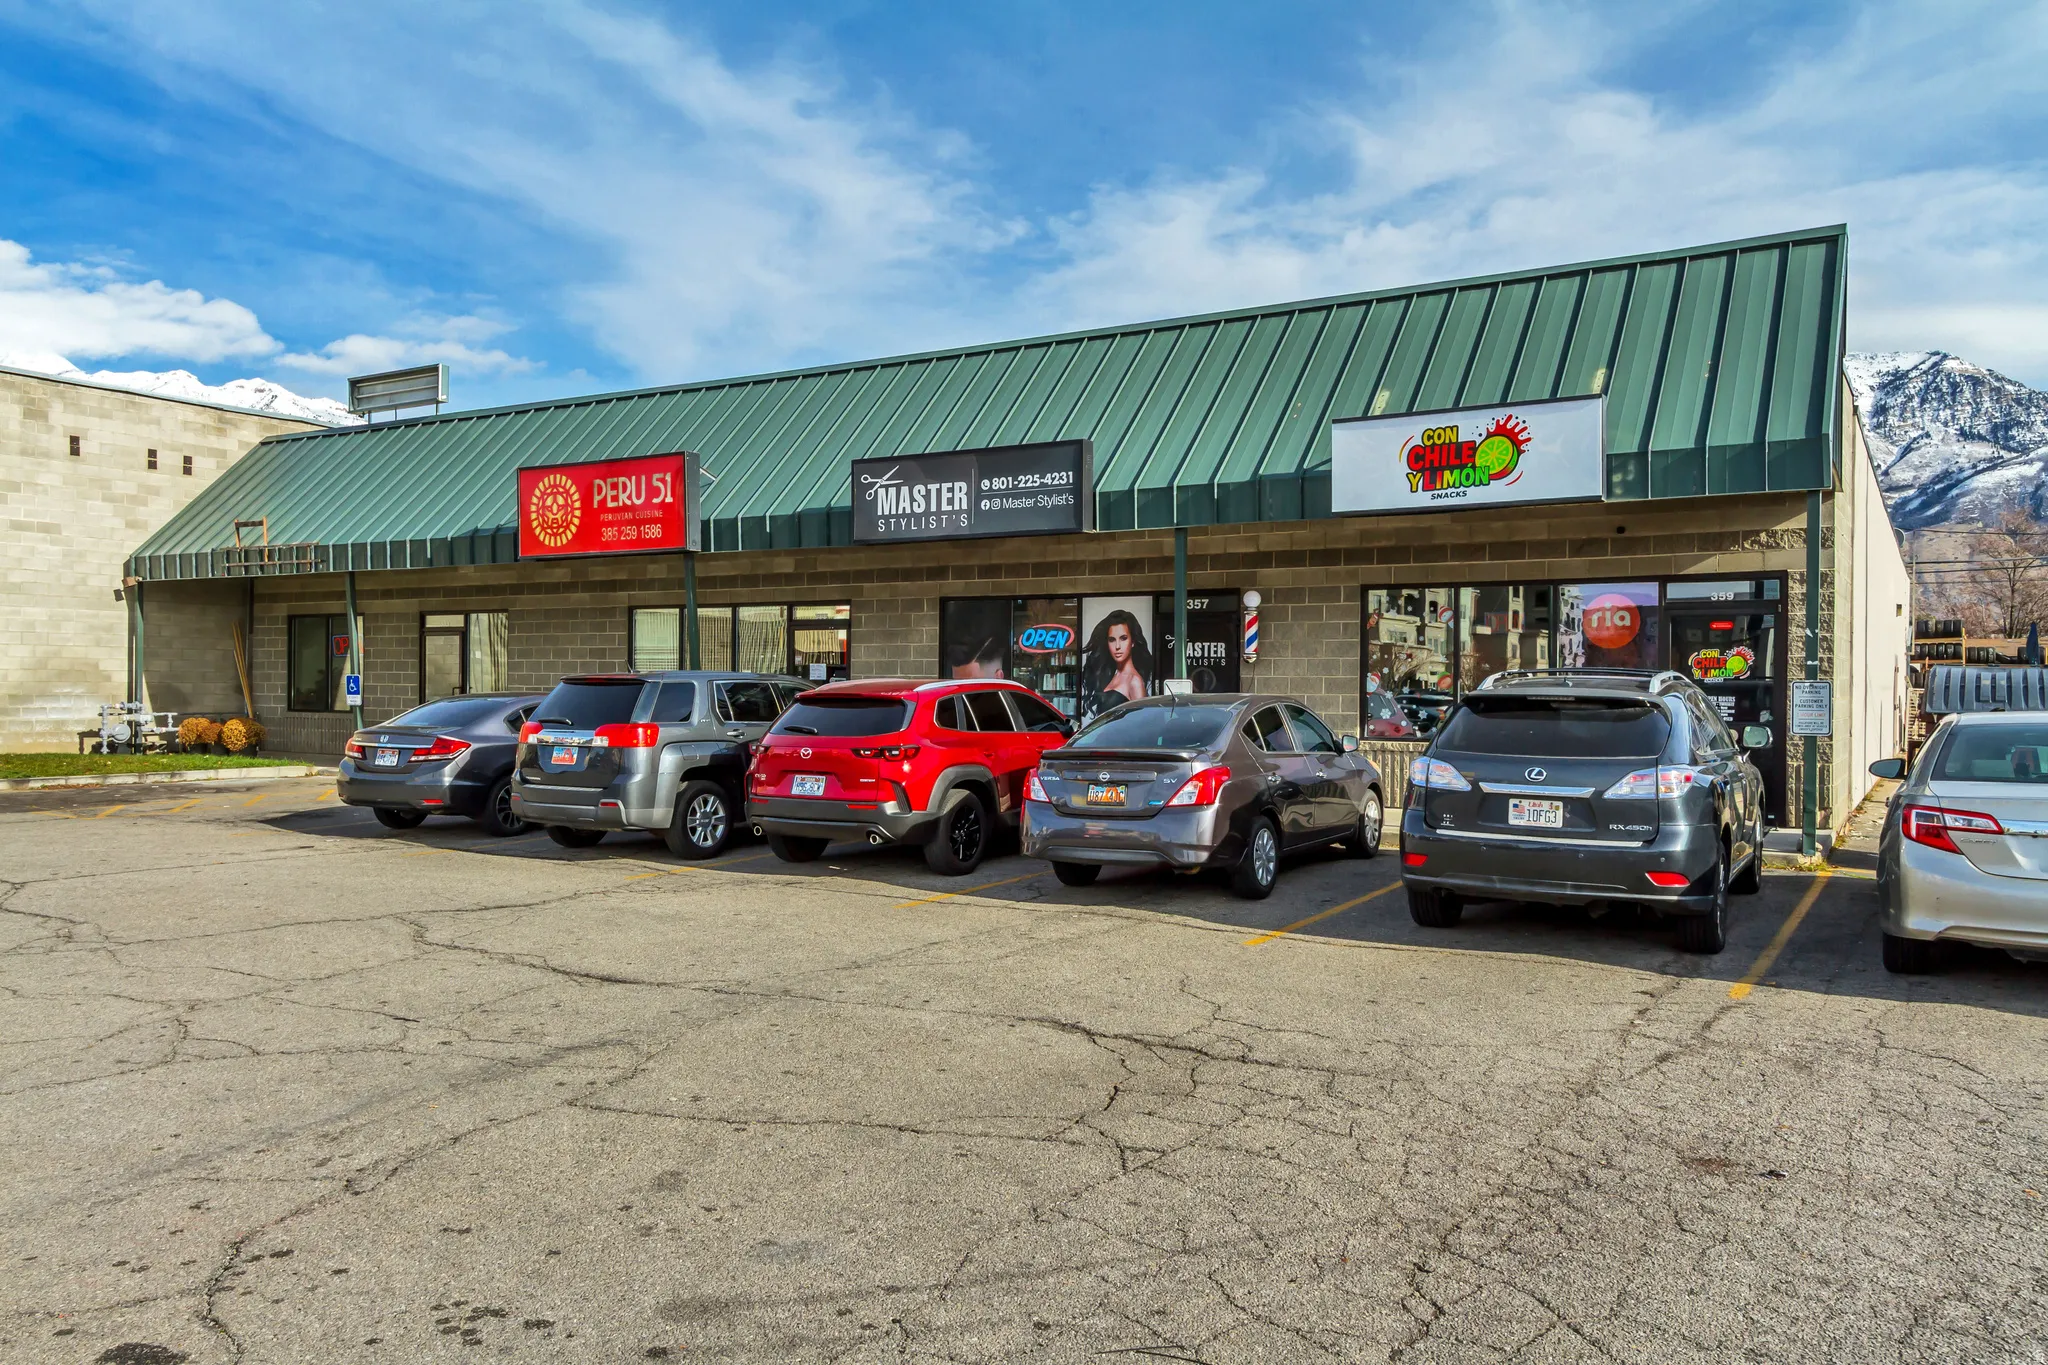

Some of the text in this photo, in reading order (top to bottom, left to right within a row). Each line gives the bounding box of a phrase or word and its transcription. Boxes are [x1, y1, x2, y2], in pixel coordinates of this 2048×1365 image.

[1423, 426, 1458, 446] CON
[1407, 441, 1475, 471] CHILE
[992, 471, 1073, 490] 801-225-4231
[1407, 464, 1490, 492] Y LIMÓN
[592, 472, 673, 509] PERU 51
[877, 481, 968, 516] MASTER
[1430, 490, 1468, 500] SNACKS
[1002, 492, 1074, 509] Master Stylist's
[600, 509, 663, 521] PERUVIAN CUISINE
[878, 513, 968, 532] STYLIST'S
[601, 523, 662, 541] 385 259 1586
[1186, 599, 1209, 609] 357
[1711, 592, 1735, 601] 359
[1591, 602, 1631, 628] ria
[1022, 628, 1069, 648] OPEN
[1186, 642, 1226, 657] ASTER
[1701, 650, 1719, 658] CON
[1693, 657, 1727, 669] CHILE
